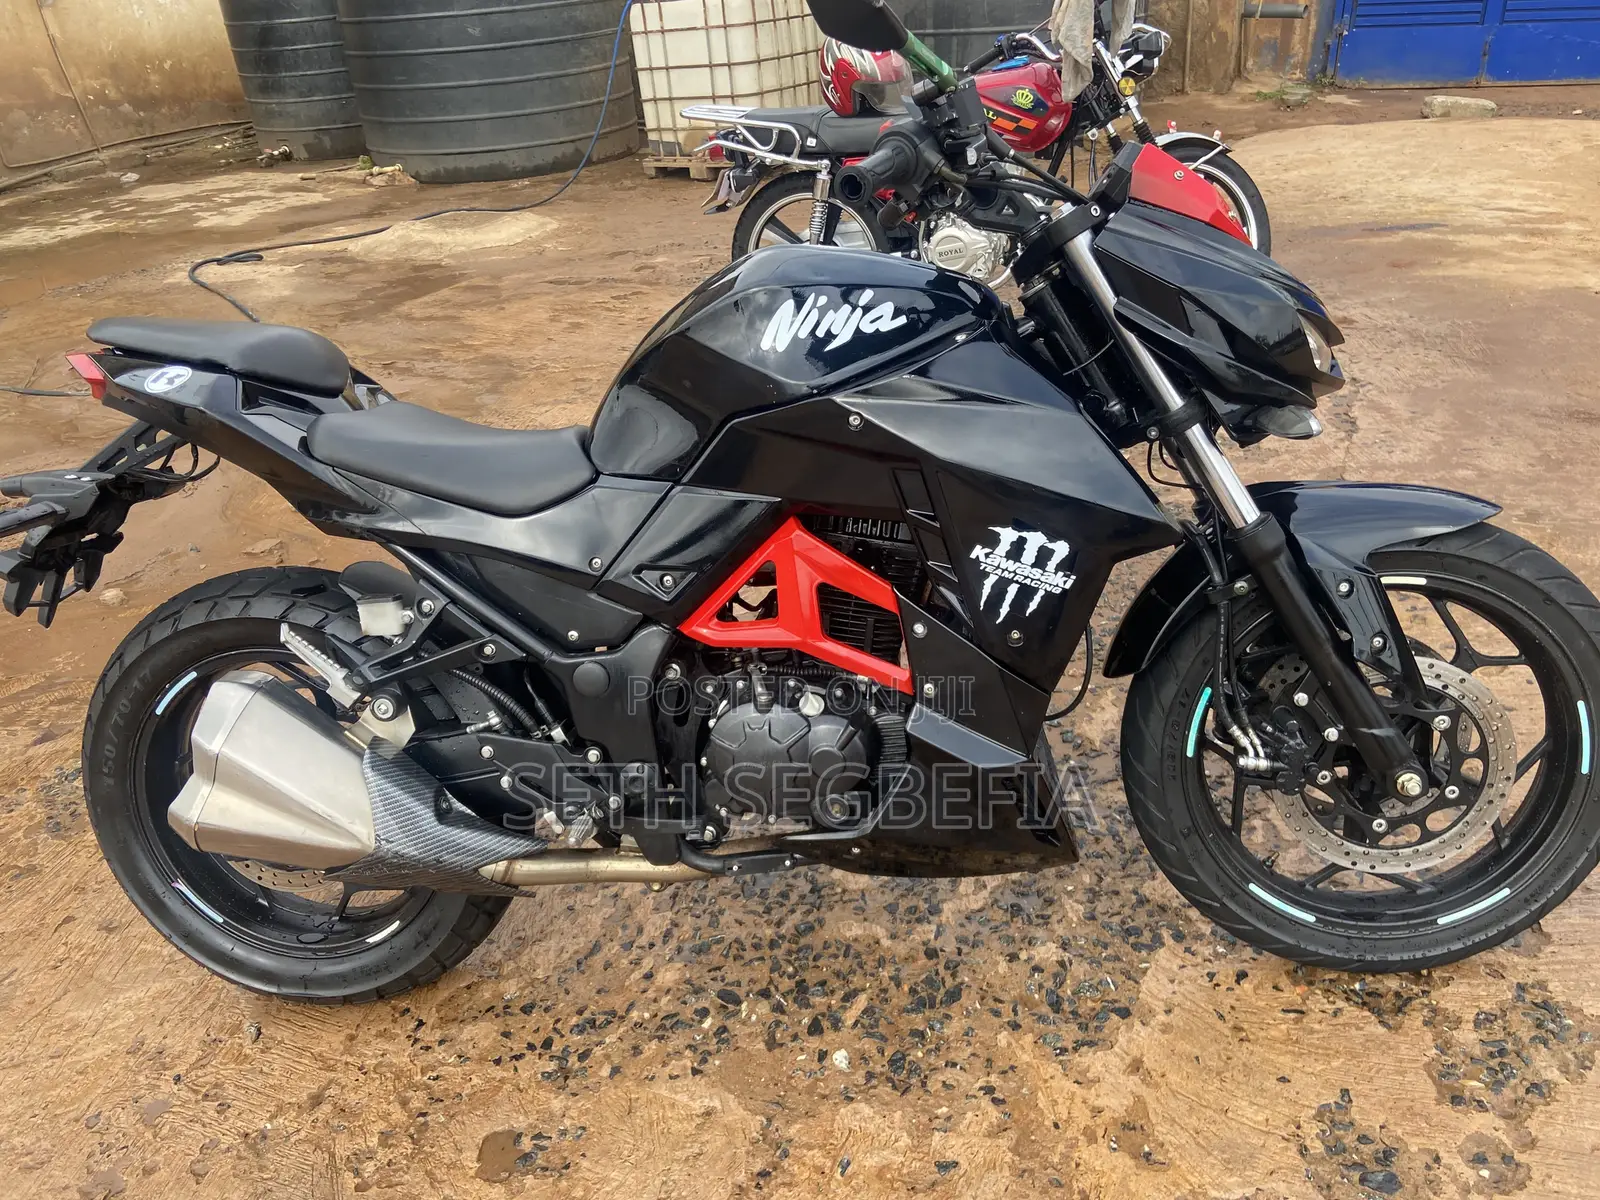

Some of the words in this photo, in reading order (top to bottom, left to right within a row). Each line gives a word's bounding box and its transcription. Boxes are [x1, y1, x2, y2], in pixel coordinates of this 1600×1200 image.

[938, 248, 964, 258] ROYAL
[760, 289, 907, 352] Ninja
[969, 544, 1076, 589] Kawasaki
[980, 563, 1013, 580] TEAM
[1013, 574, 1062, 594] RACING
